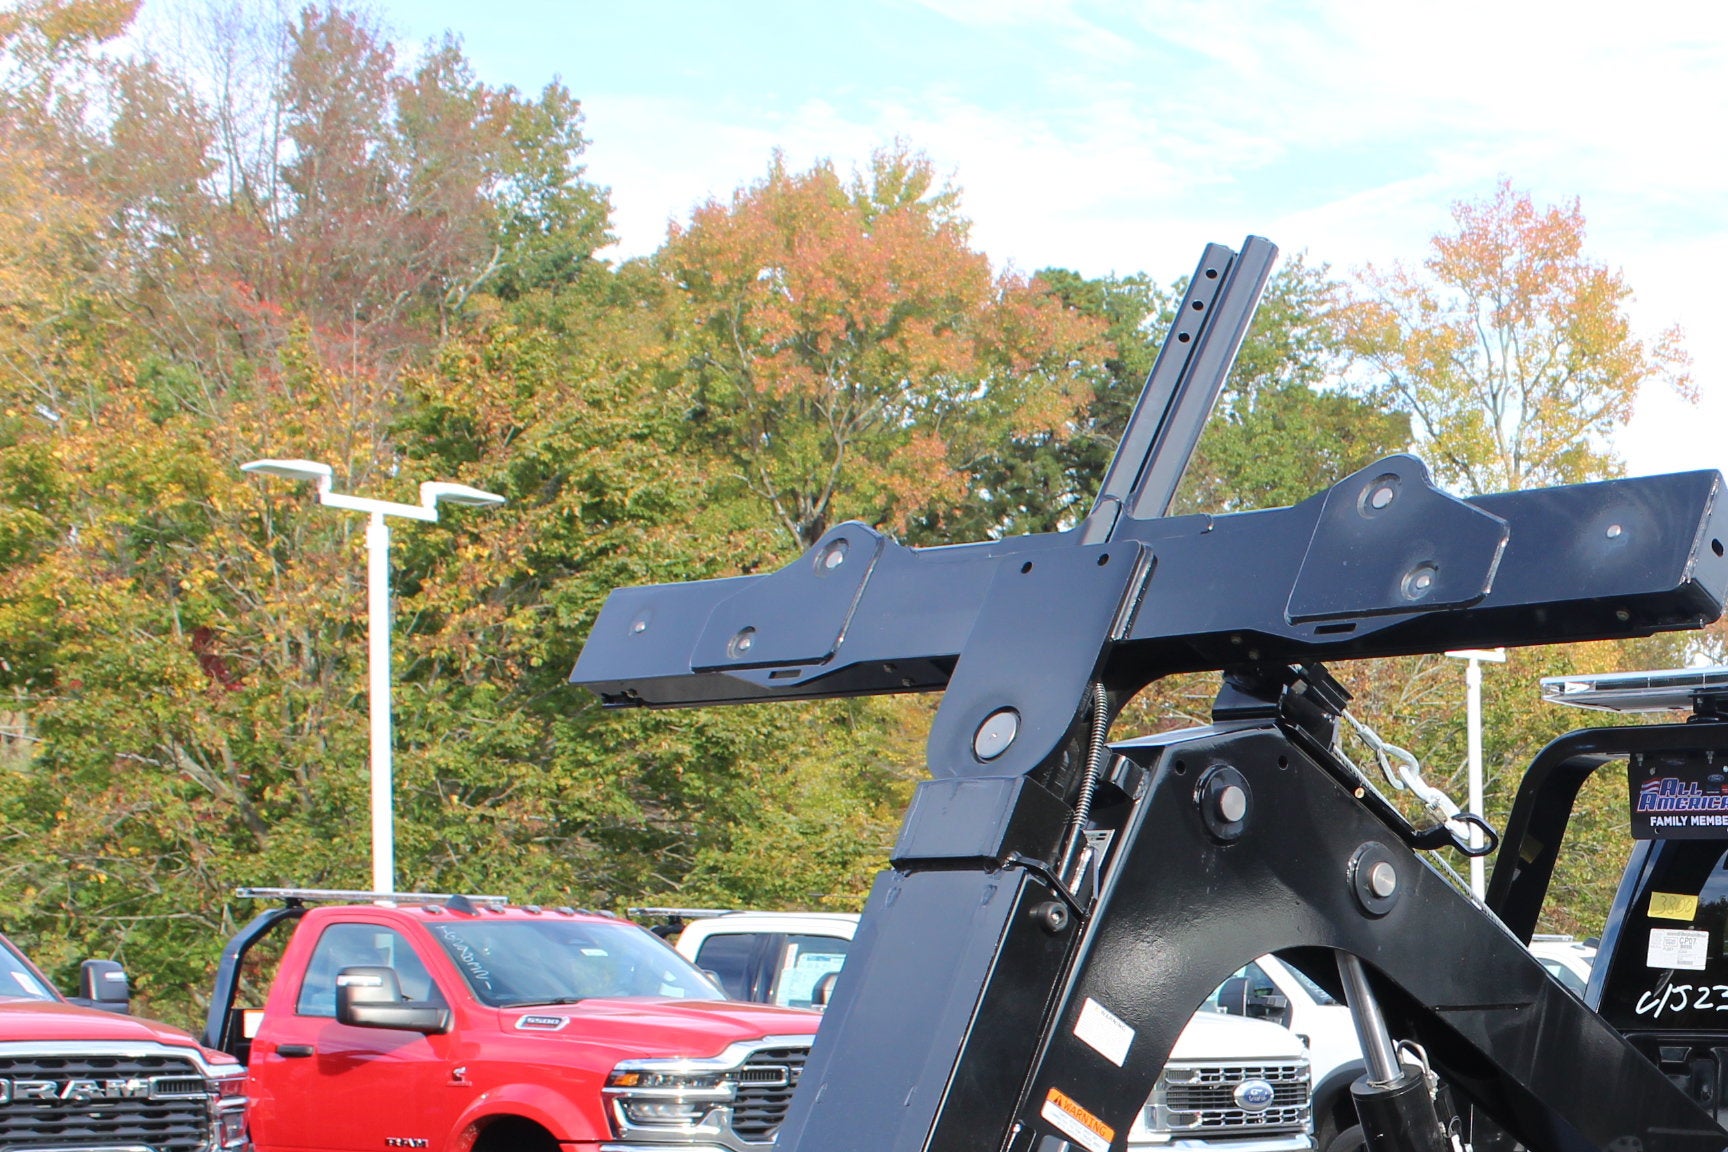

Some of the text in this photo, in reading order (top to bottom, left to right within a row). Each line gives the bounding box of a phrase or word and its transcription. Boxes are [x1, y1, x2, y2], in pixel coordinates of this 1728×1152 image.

[1659, 777, 1703, 797] ALL
[1650, 816, 1688, 826] FAMILY
[12, 1079, 149, 1100] RAM
[1062, 1100, 1107, 1137] WARNING
